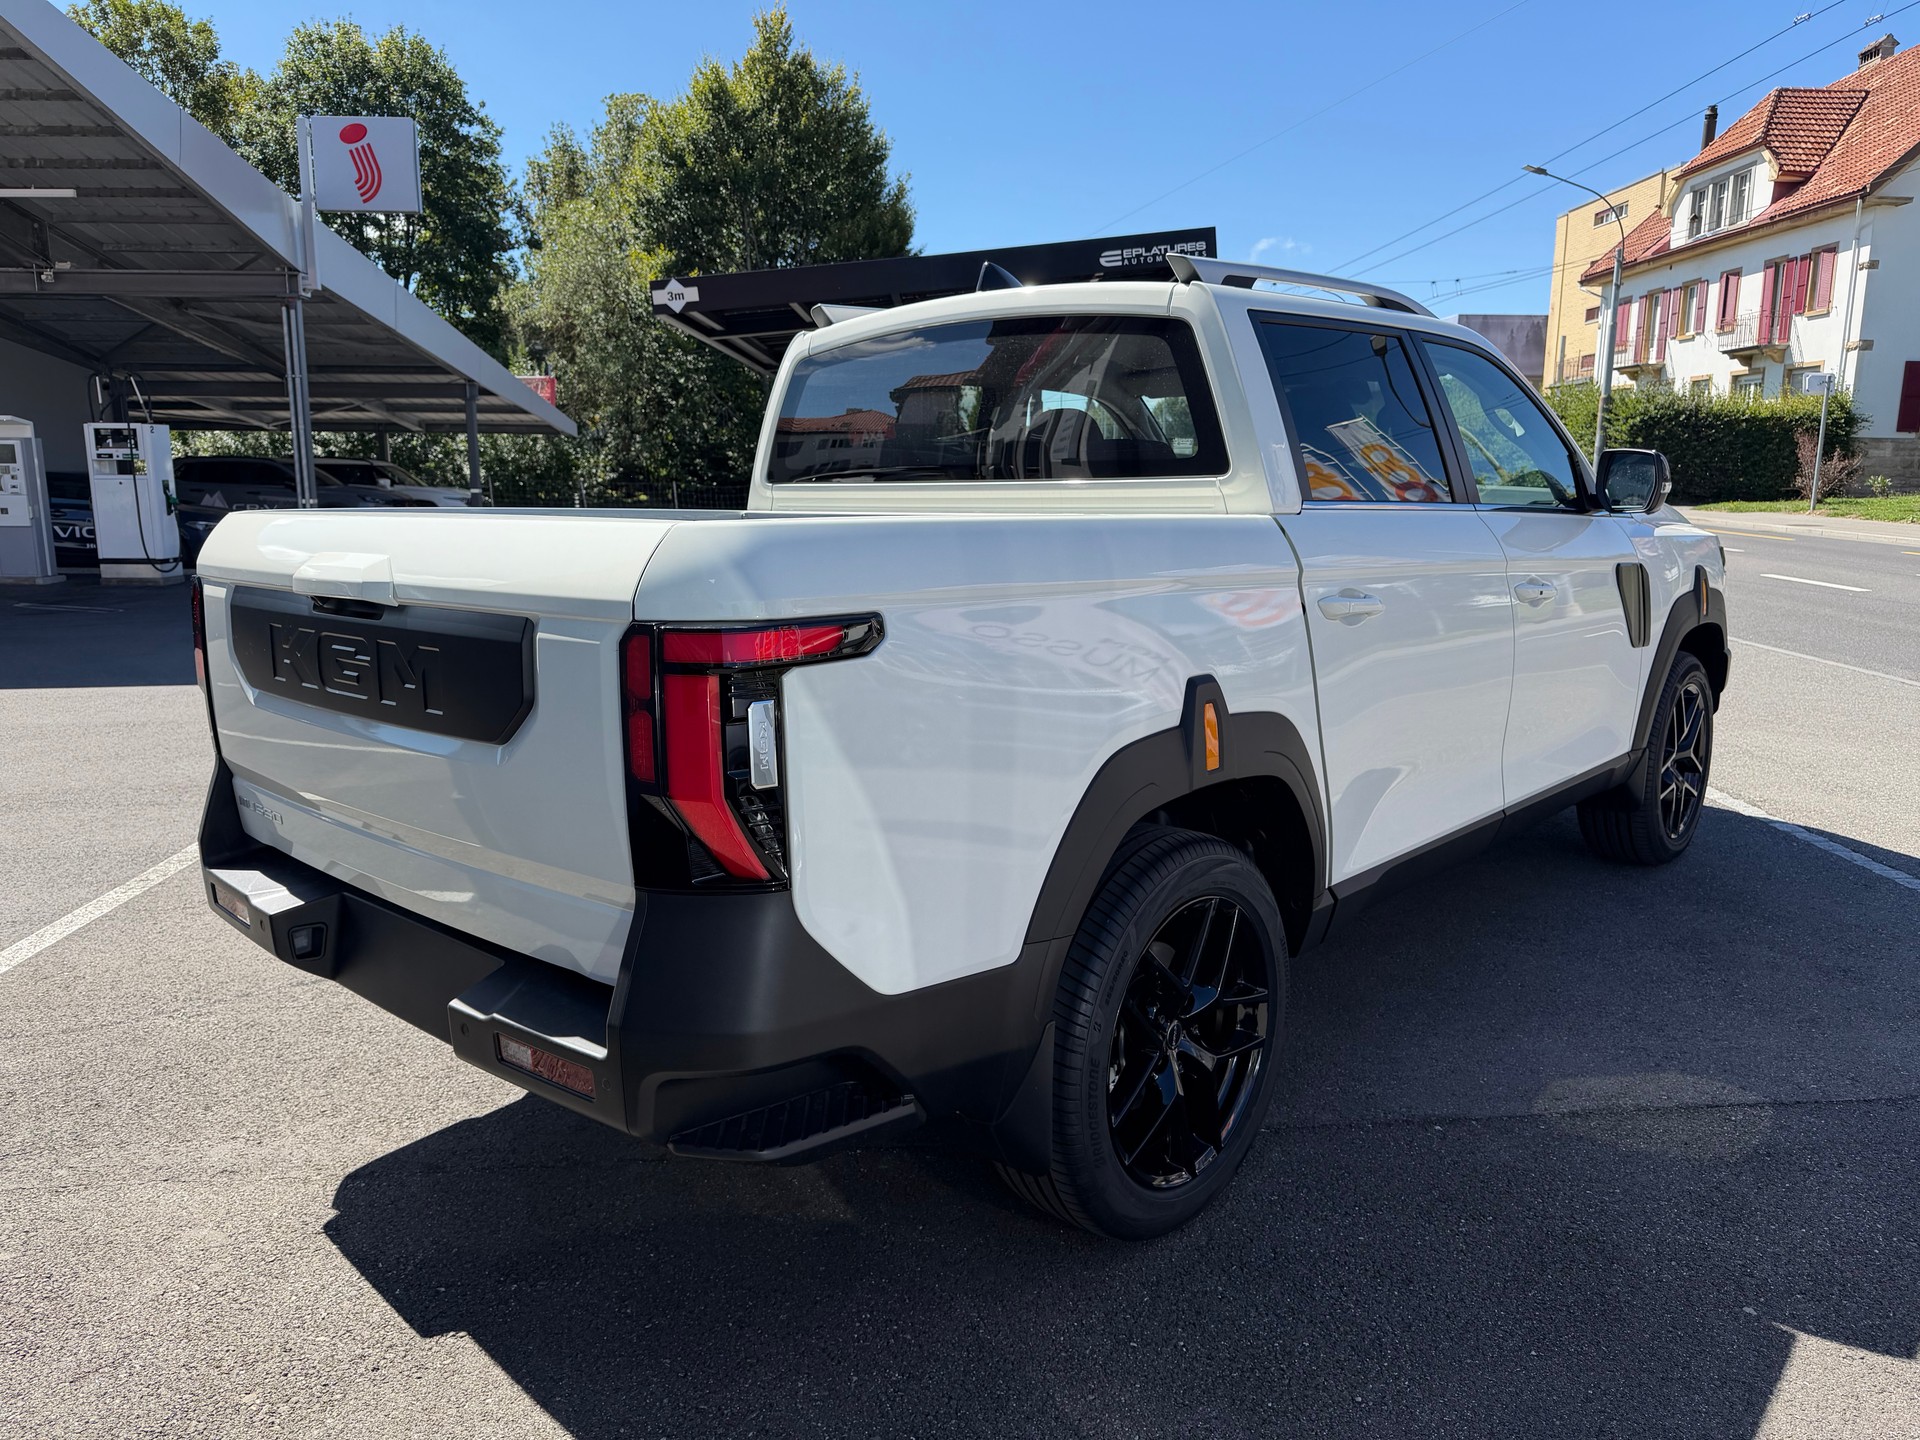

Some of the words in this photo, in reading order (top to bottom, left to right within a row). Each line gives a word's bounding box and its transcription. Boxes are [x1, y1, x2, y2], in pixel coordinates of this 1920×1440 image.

[1123, 241, 1207, 259] EPLATURES
[1123, 251, 1207, 266] AUTOMLES
[667, 291, 685, 302] 3m
[149, 425, 155, 434] 2
[269, 622, 444, 716] KGM
